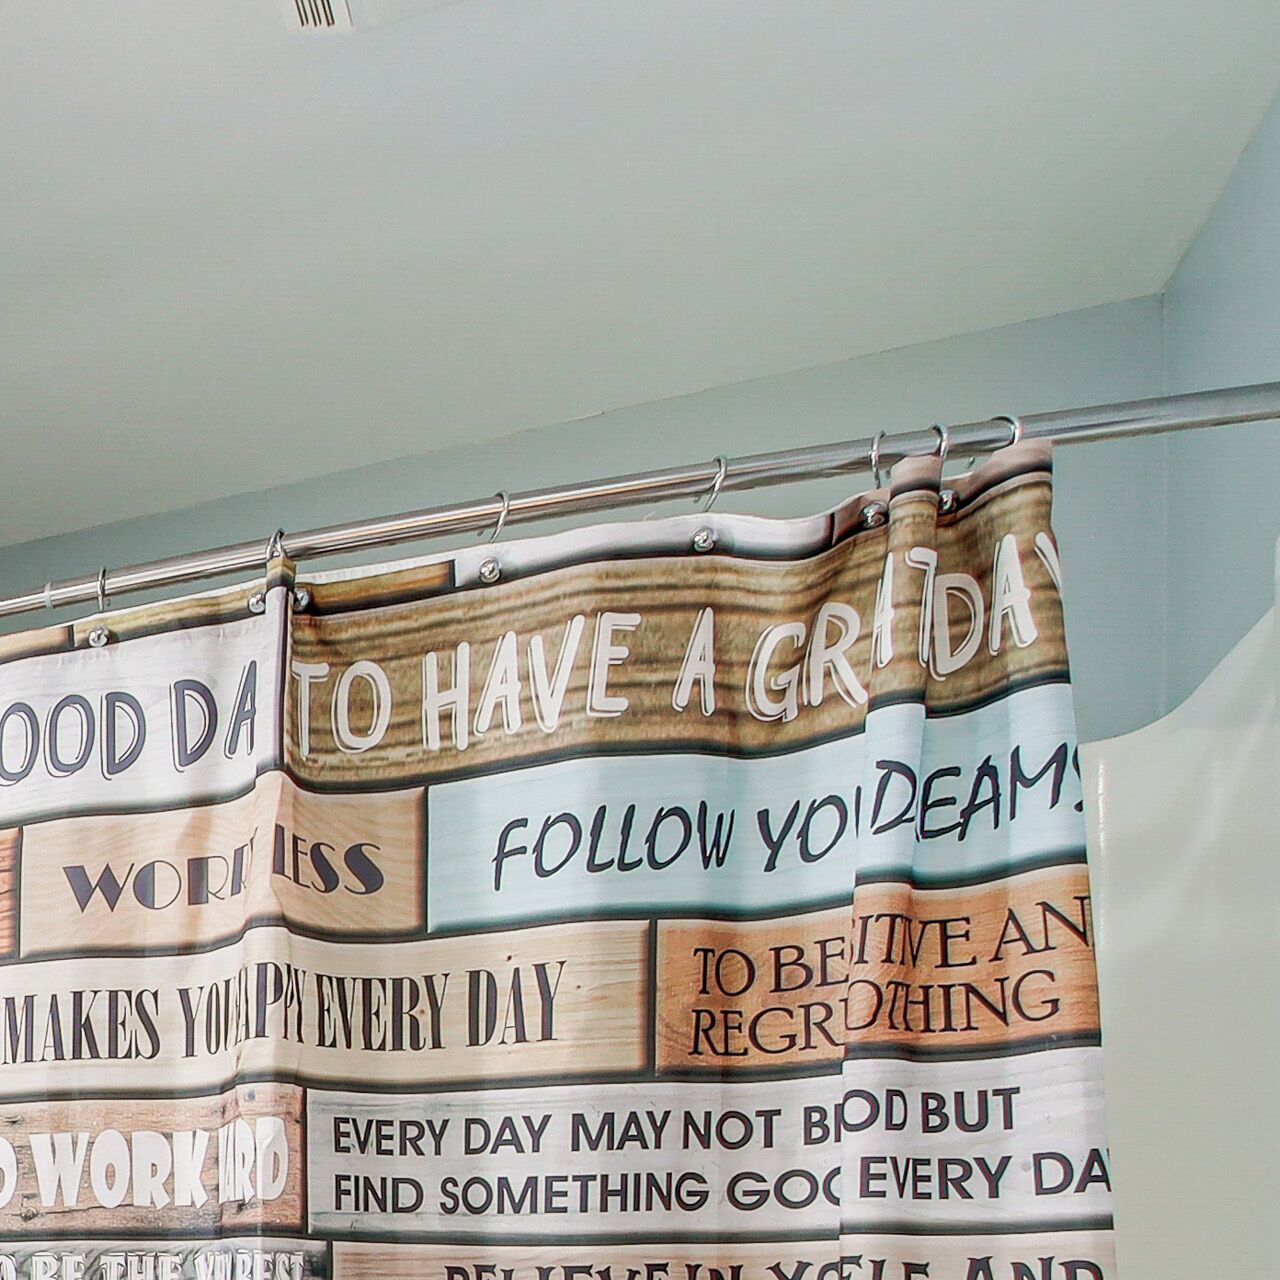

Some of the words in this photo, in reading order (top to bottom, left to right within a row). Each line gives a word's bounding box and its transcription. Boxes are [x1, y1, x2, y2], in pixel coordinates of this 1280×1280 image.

[169, 660, 259, 775] DA
[291, 660, 394, 761] TO
[422, 611, 643, 753] HAVE
[672, 606, 717, 718] A
[272, 822, 386, 896] LESS
[493, 800, 736, 892] FOLLOW
[693, 946, 756, 997] TO
[769, 936, 849, 994] BE
[988, 895, 1093, 962] AN
[2, 988, 162, 1066] MAKES
[314, 970, 451, 1052] EVERY
[465, 959, 568, 1049] DAY
[838, 969, 1062, 1034] OTHING
[332, 1116, 451, 1157] EVERY
[463, 1113, 552, 1156] DAY
[570, 1110, 672, 1153] MAY
[681, 1108, 782, 1151] NOT
[920, 1086, 1021, 1134] BUT
[28, 1128, 209, 1211] WORK
[334, 1173, 425, 1214] FIND
[439, 1170, 710, 1216] SOMETHING
[858, 1155, 1013, 1201] EVERY
[1034, 1146, 1112, 1197] DA
